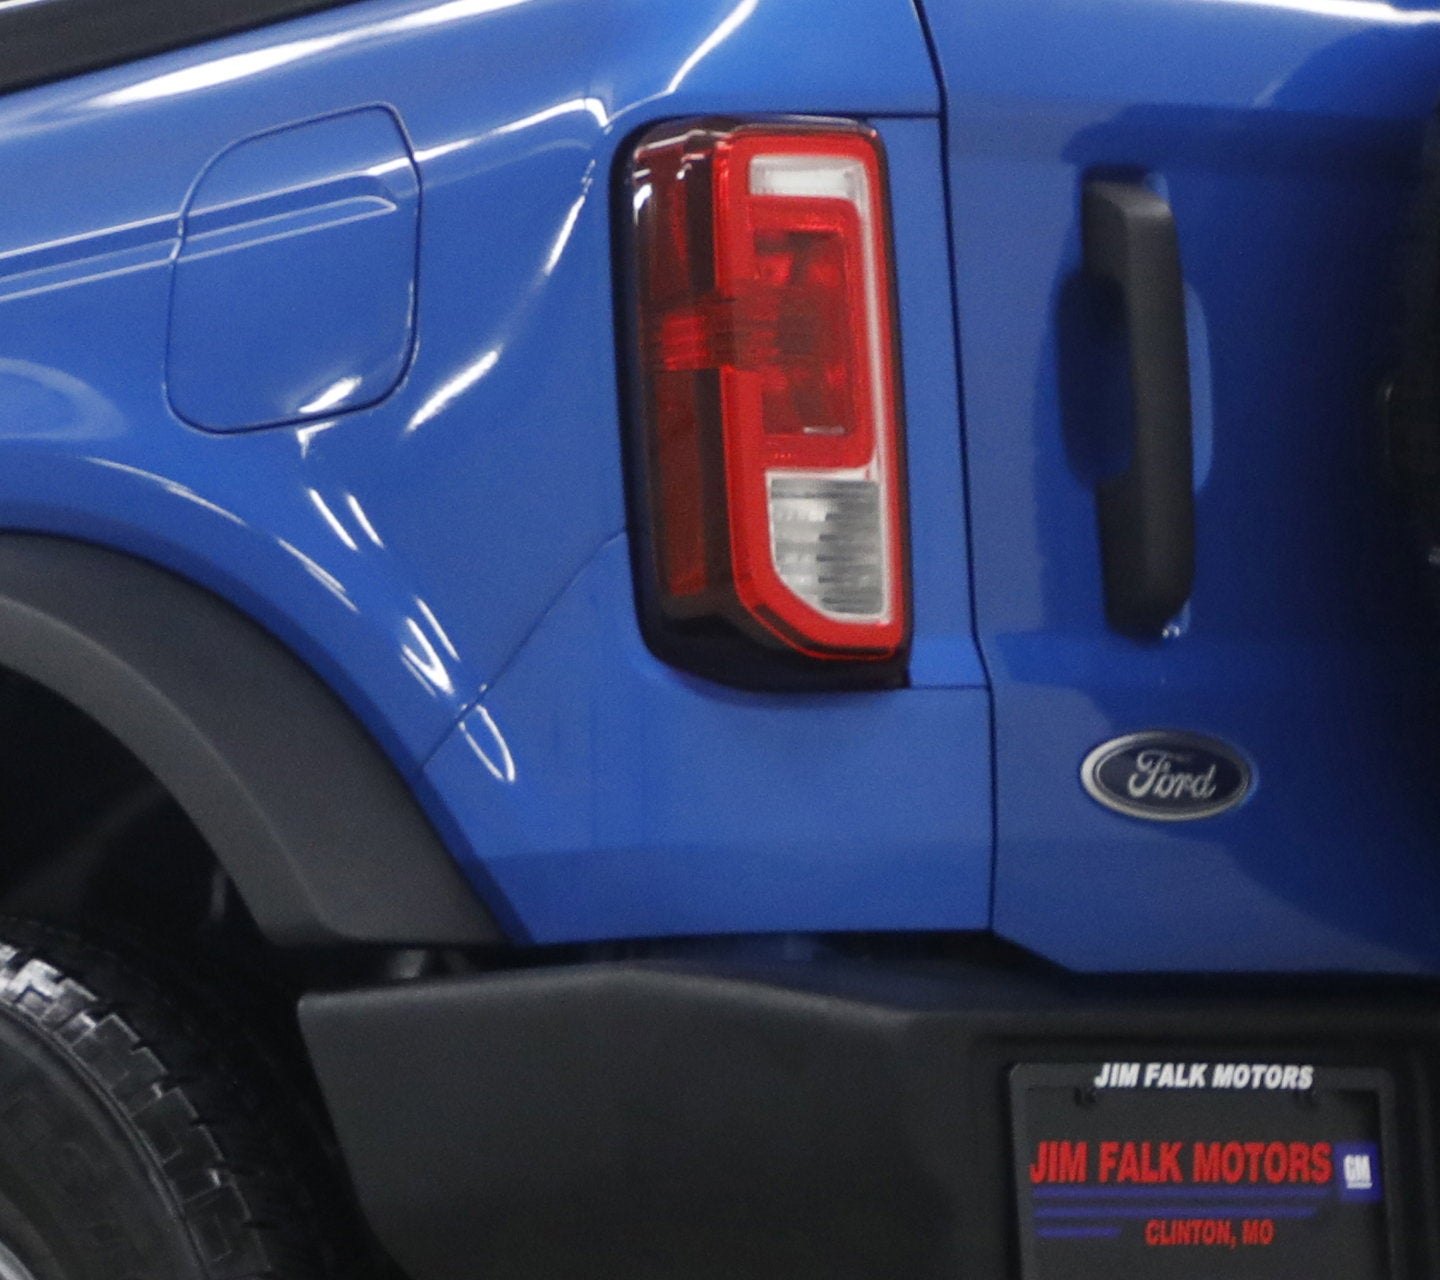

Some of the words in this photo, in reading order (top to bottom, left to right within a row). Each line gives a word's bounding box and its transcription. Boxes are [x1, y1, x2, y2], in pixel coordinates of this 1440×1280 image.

[1127, 750, 1217, 798] Ford
[1093, 1062, 1140, 1088] JIM
[1143, 1062, 1208, 1088] FALK
[1211, 1064, 1314, 1090] MOTORS
[1029, 1141, 1088, 1183] JIM
[1098, 1141, 1184, 1183] FALK
[1192, 1141, 1332, 1184] MOTORS
[1343, 1154, 1372, 1183] GM
[1144, 1219, 1237, 1249] CLINTON,
[1241, 1219, 1275, 1245] MO
